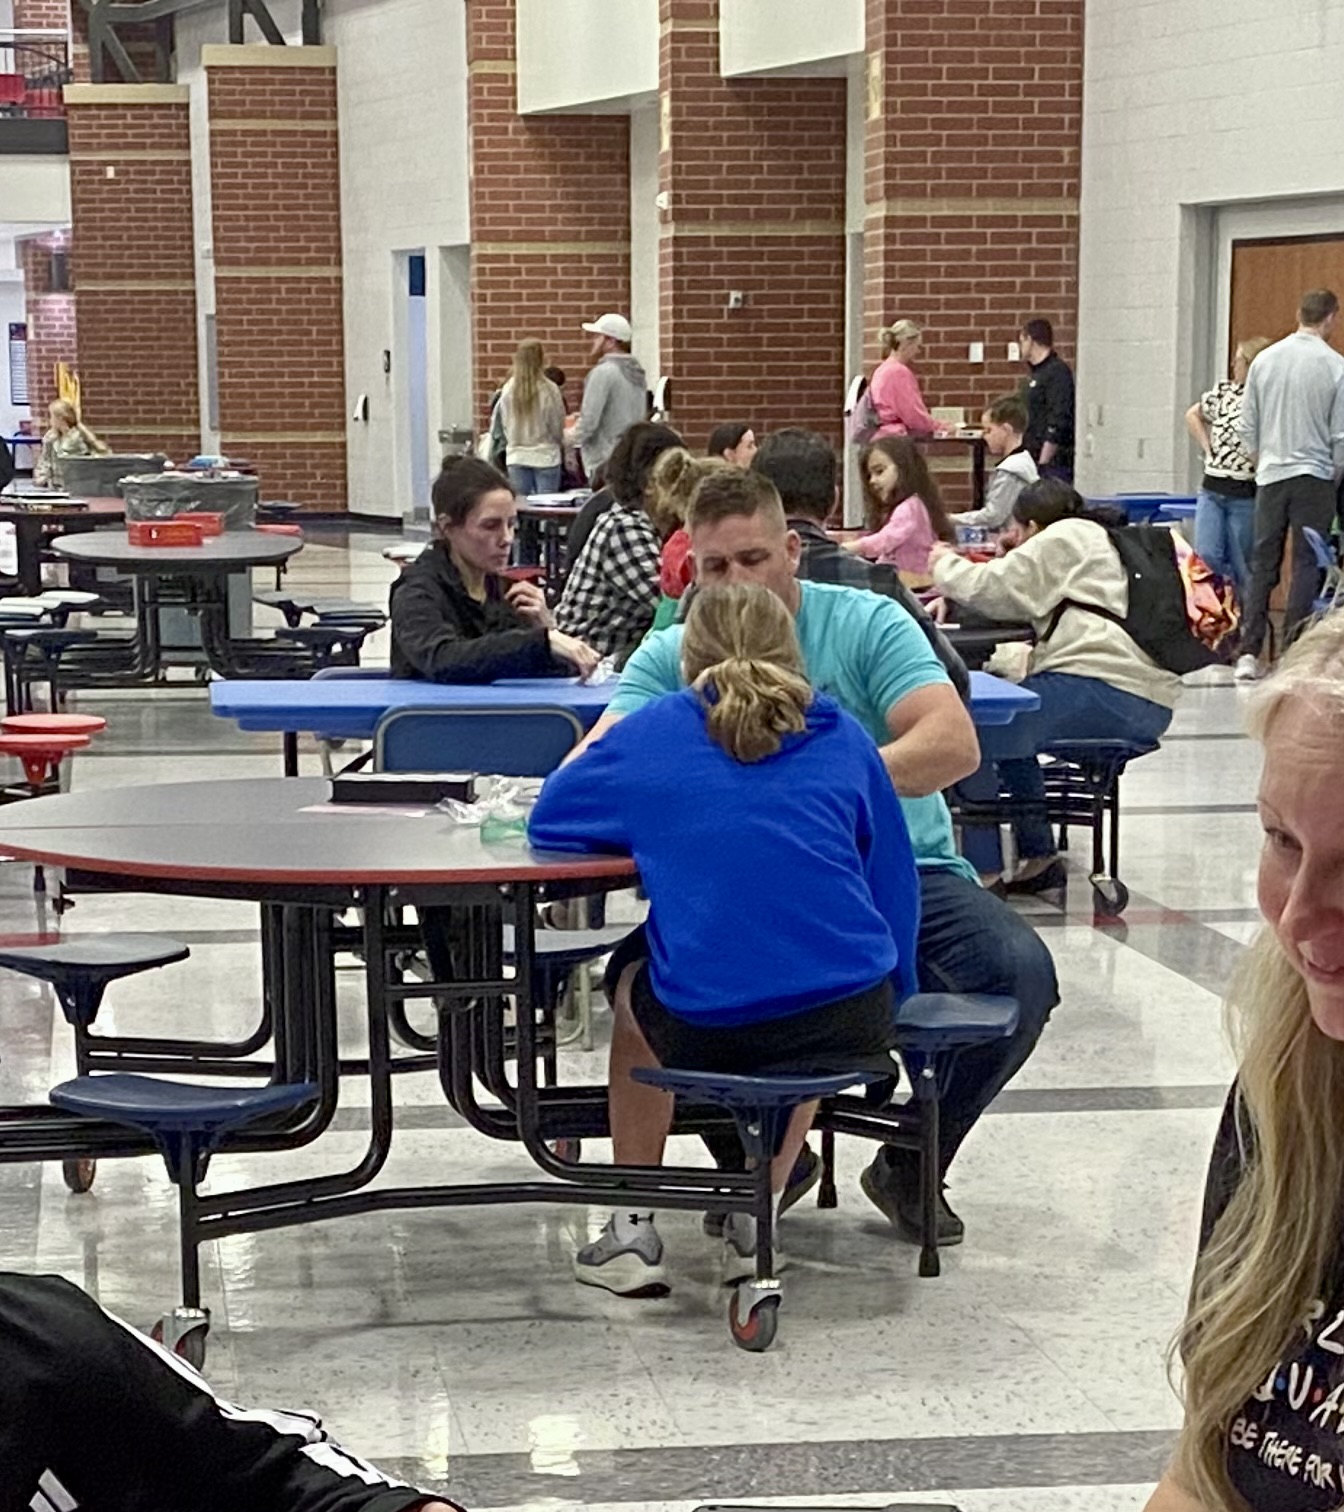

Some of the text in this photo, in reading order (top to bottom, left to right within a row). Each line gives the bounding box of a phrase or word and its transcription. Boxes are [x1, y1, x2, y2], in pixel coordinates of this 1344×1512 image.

[1230, 1417, 1258, 1450] BE
[1258, 1431, 1304, 1476] THERE
[1303, 1453, 1336, 1490] FOR
